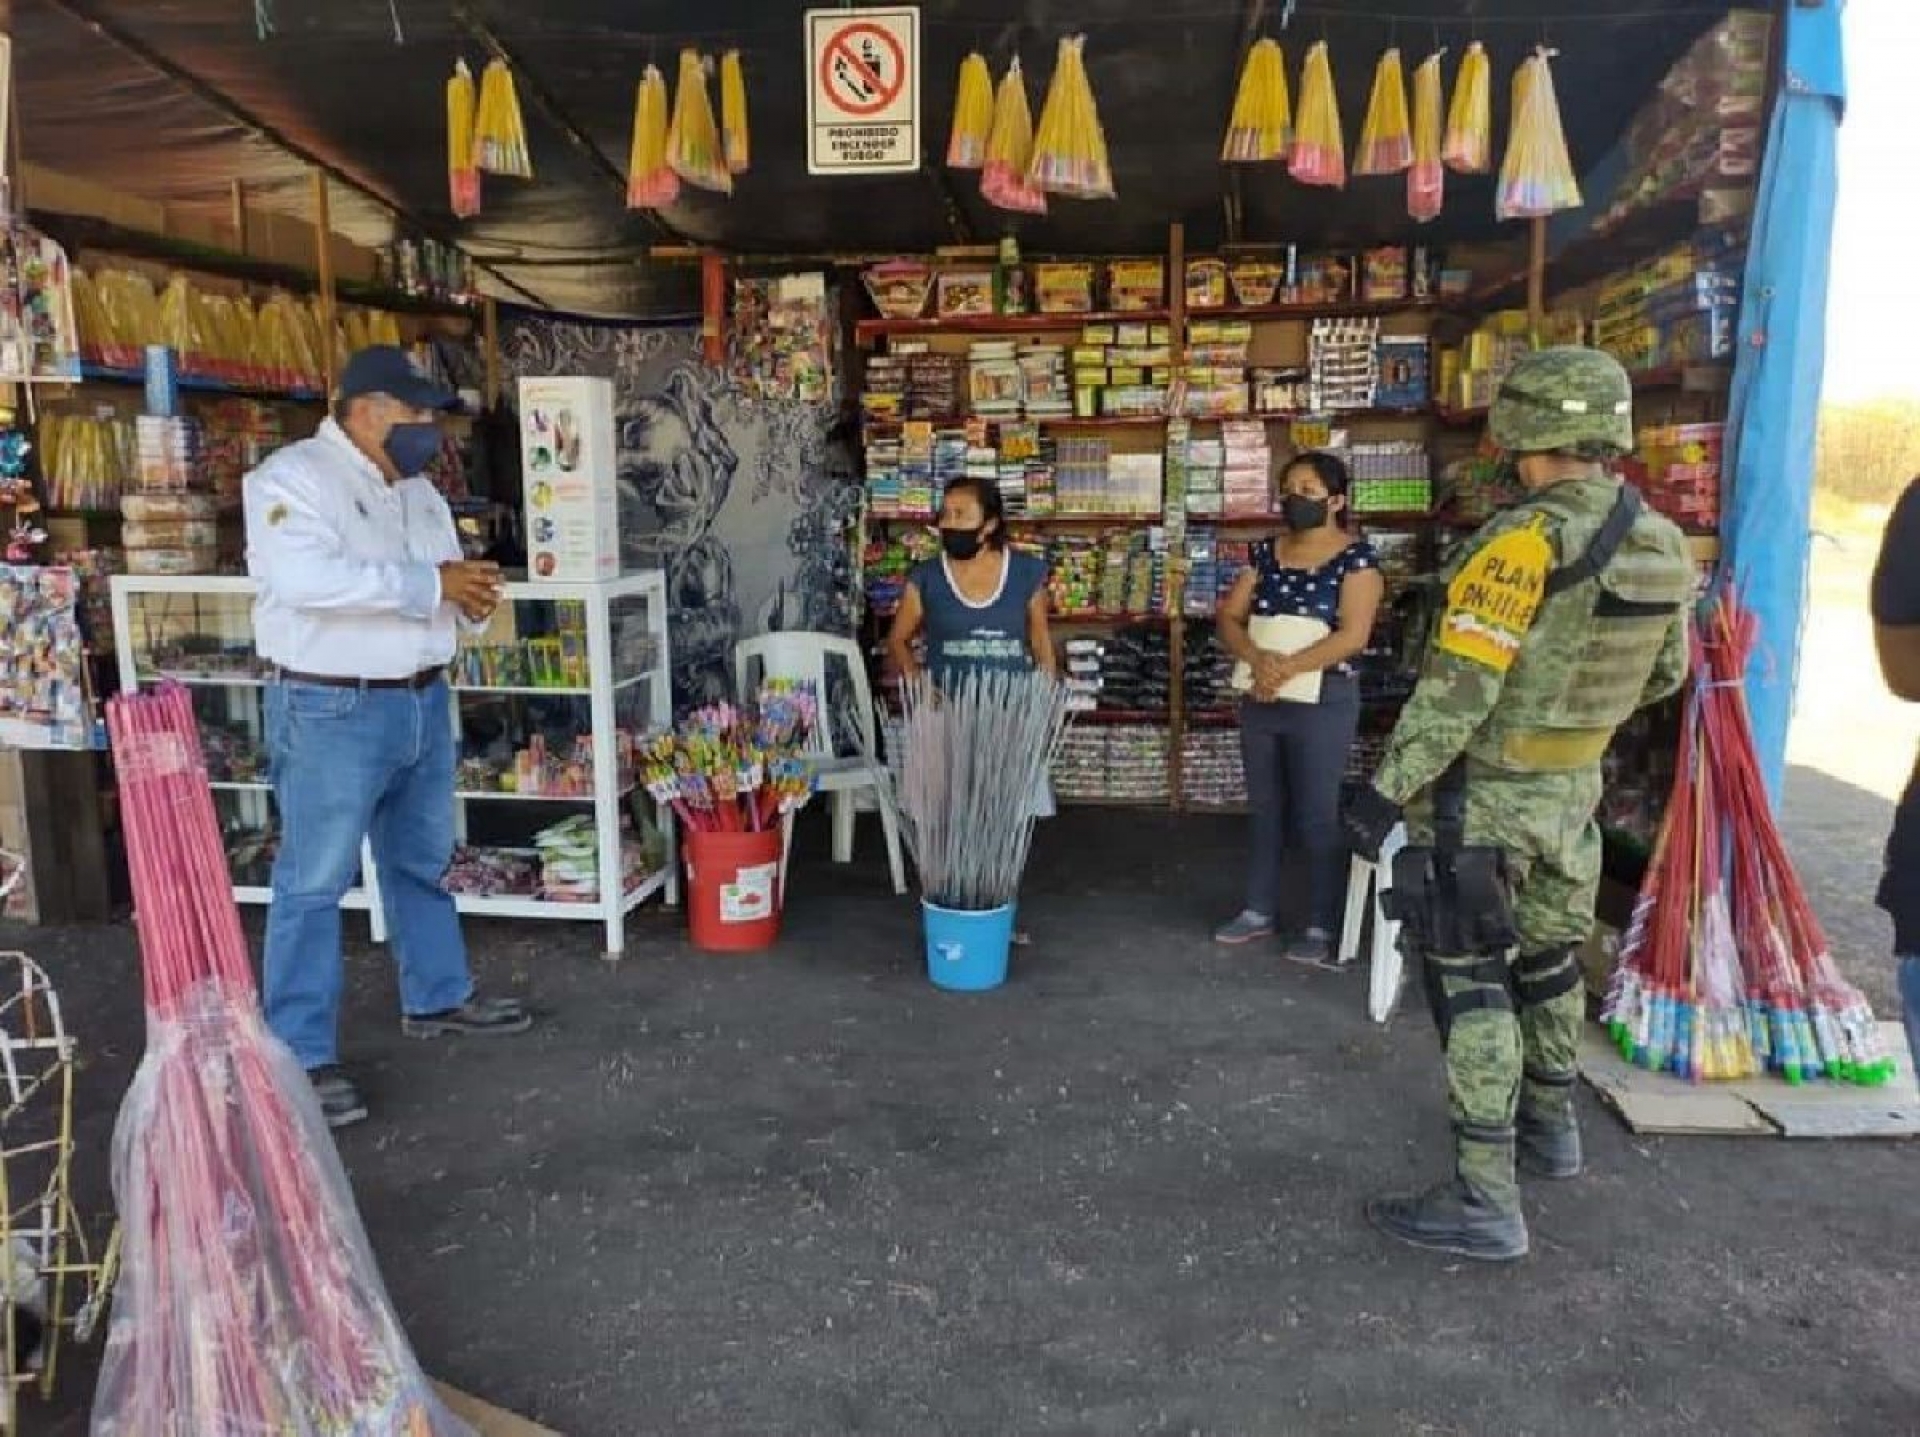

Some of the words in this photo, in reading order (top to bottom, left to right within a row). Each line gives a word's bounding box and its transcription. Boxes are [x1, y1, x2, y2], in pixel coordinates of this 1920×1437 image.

[828, 127, 898, 138] PROHIBIDO
[832, 138, 895, 150] ENCENDER
[843, 150, 884, 160] FUEGO
[1482, 556, 1543, 593] PLAN
